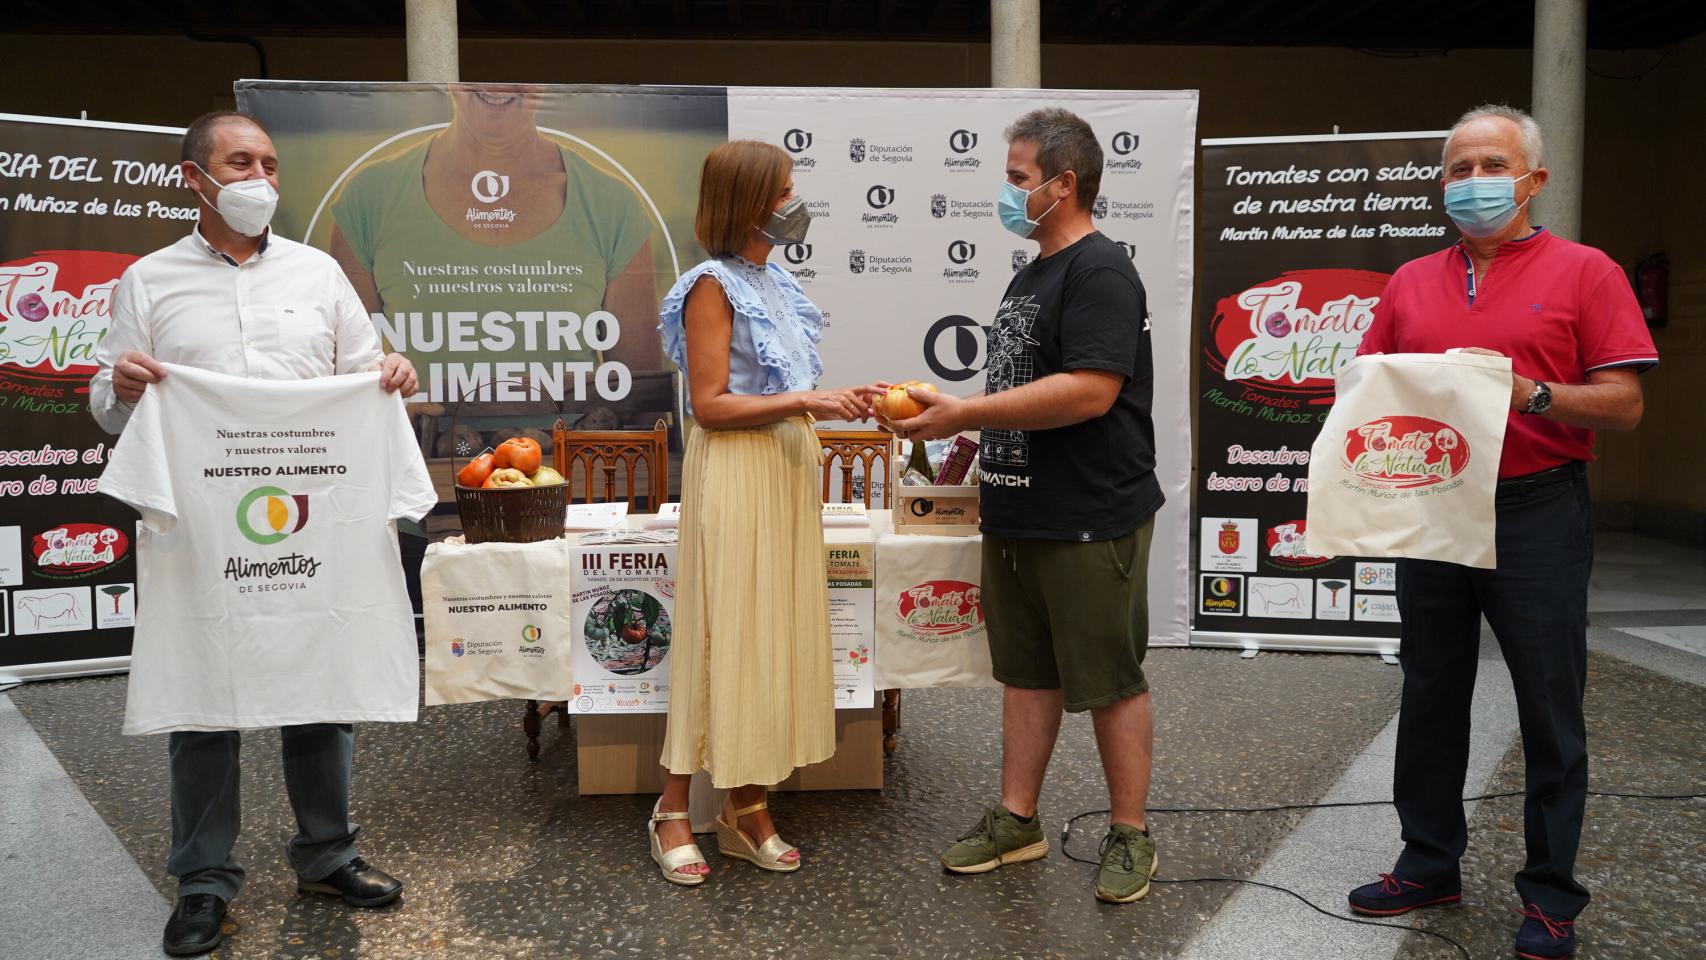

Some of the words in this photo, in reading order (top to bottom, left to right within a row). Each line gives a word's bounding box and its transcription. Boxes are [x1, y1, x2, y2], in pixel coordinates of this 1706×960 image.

[869, 144, 913, 154] Diputación
[869, 154, 880, 162] de
[882, 154, 913, 164] Segovia
[944, 157, 982, 168] Alimentos
[1106, 158, 1143, 169] Alimentos
[0, 152, 42, 178] RIA
[48, 155, 103, 182] DEL
[112, 160, 189, 188] TOMA
[1225, 164, 1321, 186] Tomates
[1326, 166, 1369, 183] con
[1376, 161, 1443, 182] sabor
[14, 193, 79, 213] Muñoz
[83, 197, 108, 215] de
[113, 199, 142, 217] las
[147, 200, 200, 220] Posad
[950, 200, 993, 210] Diputación
[1111, 201, 1154, 211] Diputación
[1233, 195, 1262, 215] de
[1269, 193, 1356, 214] nuestra
[1363, 192, 1433, 212] tierra.
[466, 207, 517, 222] Alimentos
[809, 210, 830, 218] govia
[862, 212, 899, 223] Alimentos
[963, 210, 993, 219] Segovia
[1124, 211, 1154, 219] Segovia
[1220, 227, 1268, 241] Martín
[1272, 226, 1323, 241] Muñoz
[1326, 225, 1347, 239] de
[1351, 224, 1375, 238] las
[1379, 223, 1446, 238] Posadas
[869, 255, 912, 265] Diputación
[403, 261, 478, 276] Nuestras
[484, 261, 583, 276] costumbres
[869, 265, 880, 273] de
[882, 265, 912, 275] Segovia
[943, 267, 980, 278] Alimentos
[413, 283, 423, 298] y
[429, 280, 503, 294] nuestros
[508, 279, 573, 294] valores:
[370, 310, 620, 352] NUESTRO
[405, 361, 632, 403] IMENTO
[0, 382, 64, 397] omates
[1240, 387, 1301, 409] Tomates
[13, 396, 80, 414] Muñoz
[1202, 388, 1253, 416] Martín
[1256, 406, 1313, 423] Muñoz
[216, 428, 268, 439] Nuestras
[270, 428, 336, 438] costumbres
[0, 444, 77, 466] escubre
[82, 443, 104, 464] el
[225, 447, 233, 458] y
[235, 446, 285, 455] nuestros
[287, 444, 327, 454] valores
[1227, 444, 1309, 465] Descubre
[204, 466, 272, 478] NUESTRO
[276, 465, 347, 476] ALIMENTO
[28, 474, 57, 496] de
[1207, 471, 1263, 491] tesoro
[1266, 473, 1290, 492] de
[1415, 489, 1429, 497] las
[582, 553, 601, 569] III
[609, 553, 668, 569] FERIA
[829, 550, 860, 559] FERIA
[224, 552, 322, 581] Alimentos
[239, 585, 253, 593] DE
[257, 582, 307, 593] SEGOVIA
[448, 604, 495, 613] NUESTRO
[498, 603, 548, 611] ALIMENTO
[467, 641, 503, 649] Diputación
[478, 648, 503, 656] Segovia
